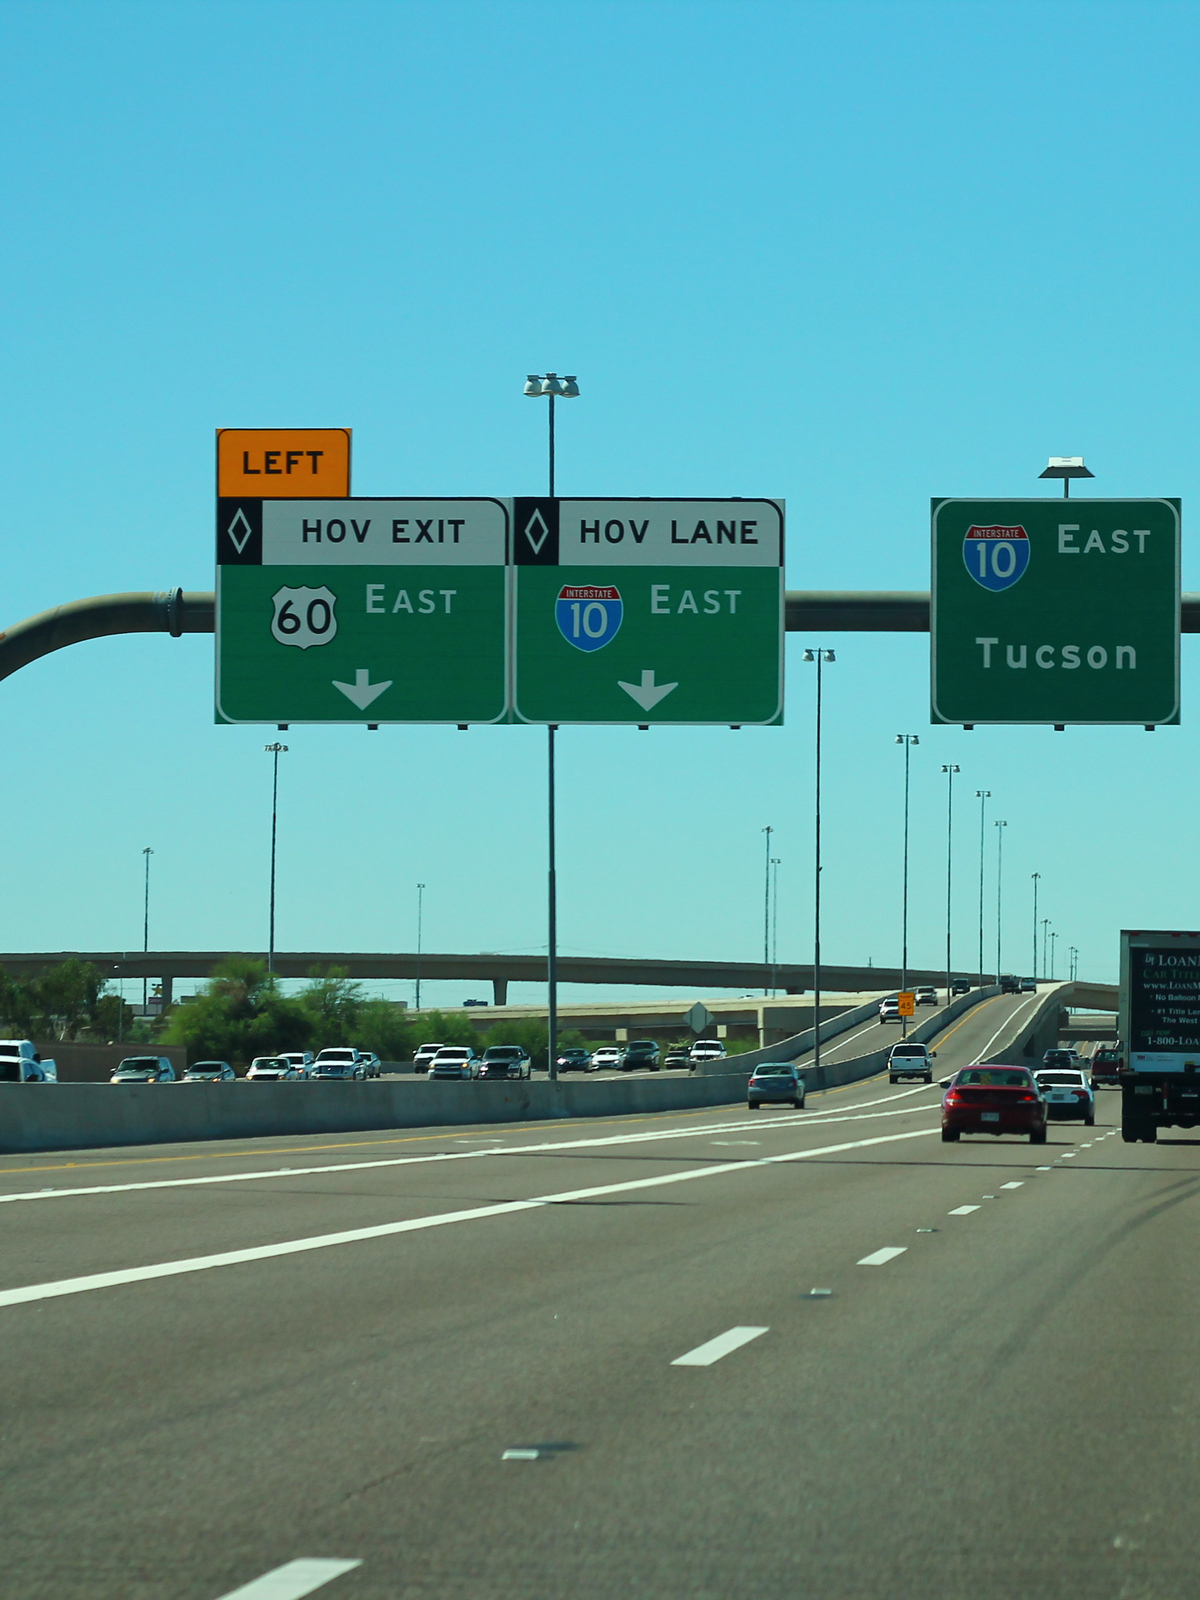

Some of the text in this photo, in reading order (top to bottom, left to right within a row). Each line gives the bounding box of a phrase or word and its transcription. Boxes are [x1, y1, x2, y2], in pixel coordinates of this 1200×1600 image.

[242, 450, 324, 475] LEFT
[301, 518, 466, 544] HOV EXIT
[579, 519, 759, 545] HOV LANE
[972, 528, 1020, 539] INTERSTATE
[1057, 523, 1151, 554] EAST
[975, 541, 1017, 579] 10
[365, 583, 457, 614] EAST
[565, 588, 613, 600] INTERSTATE
[650, 584, 742, 614] EAST
[276, 598, 332, 635] 60
[570, 602, 608, 639] 10
[975, 636, 1138, 670] Tucson
[1143, 969, 1167, 979] CAR
[1170, 969, 1200, 979] TITLE
[901, 1002, 912, 1010] 45
